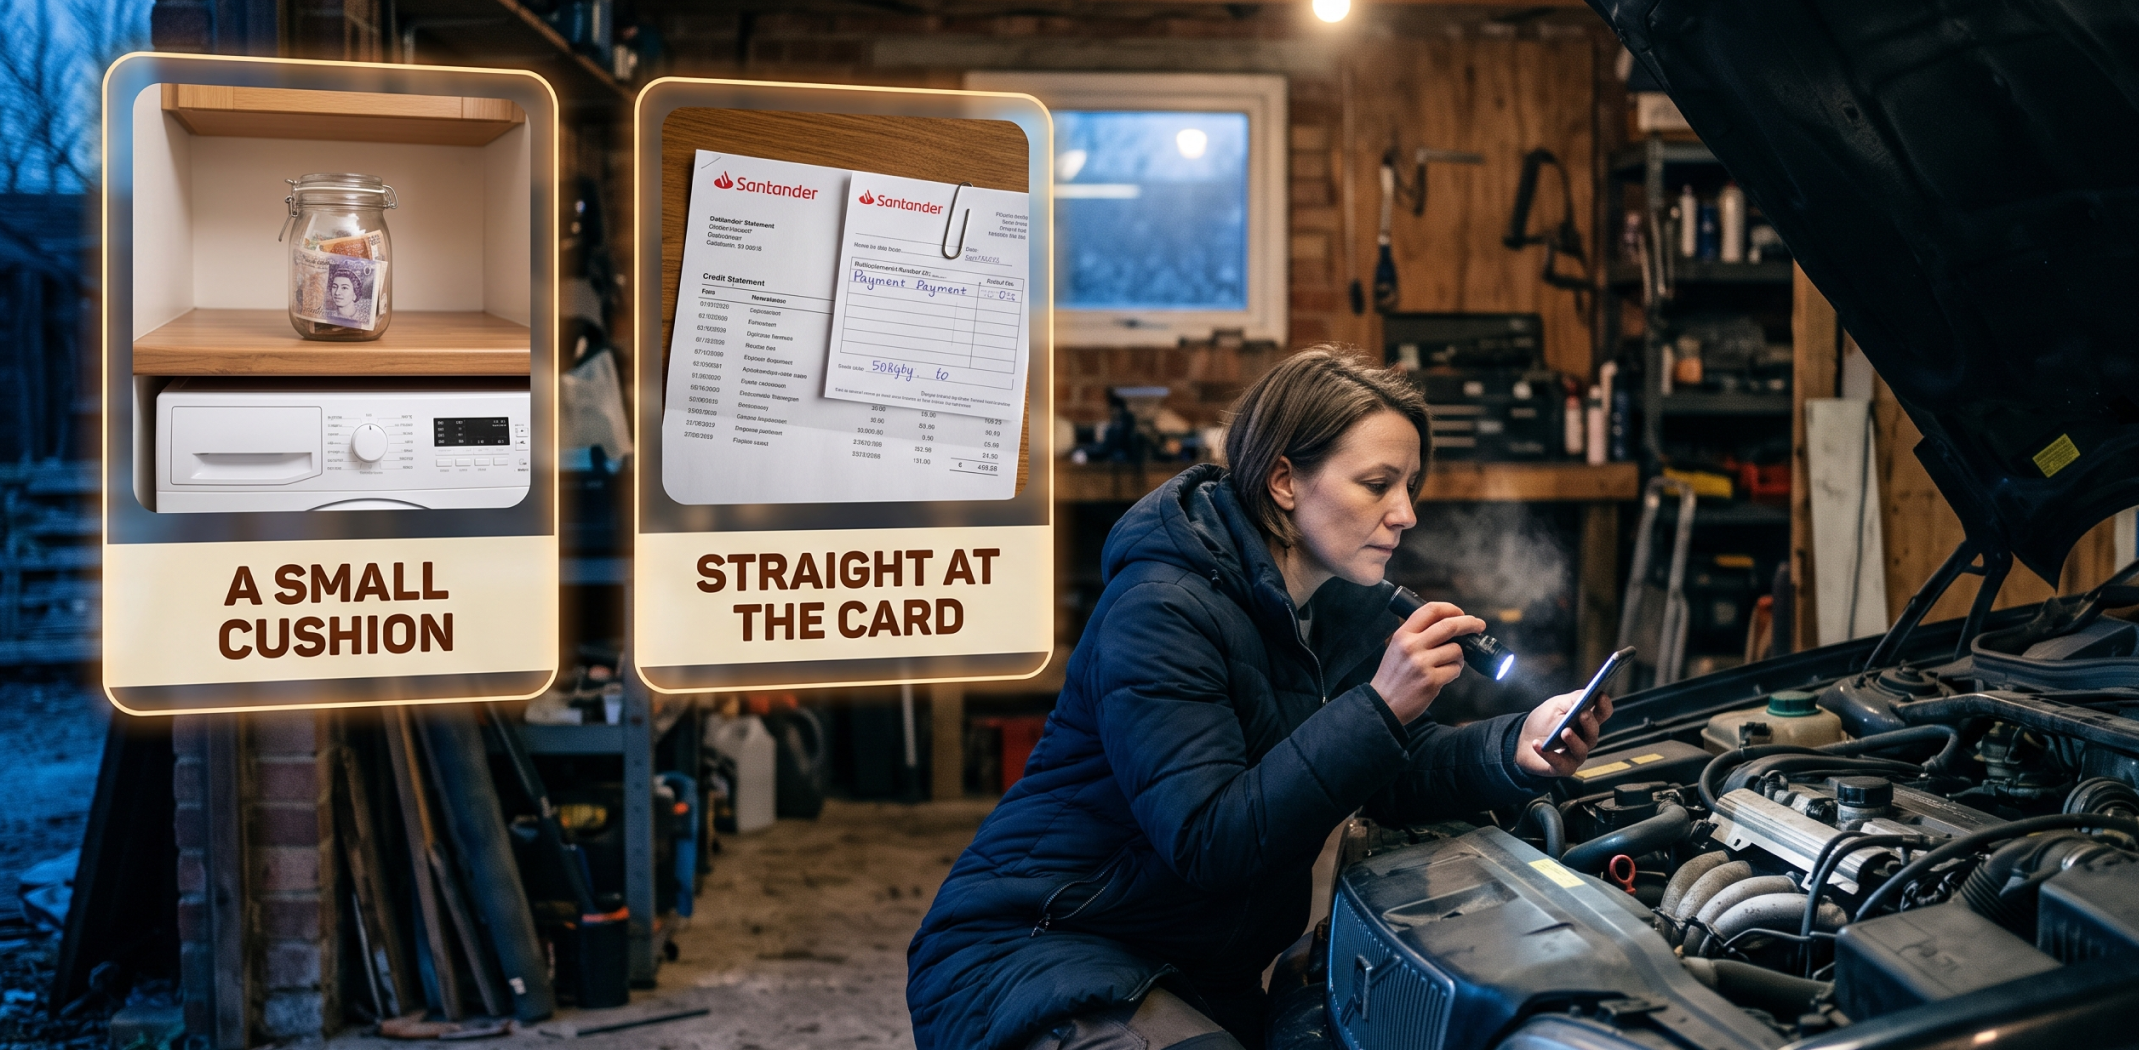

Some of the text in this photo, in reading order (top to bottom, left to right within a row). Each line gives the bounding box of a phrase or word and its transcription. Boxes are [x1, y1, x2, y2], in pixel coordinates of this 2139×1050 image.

[736, 176, 818, 200] Santander
[876, 194, 944, 215] Santander
[743, 219, 775, 229] Statement
[702, 272, 765, 287] Credit Statement
[853, 269, 906, 290] Payment
[916, 279, 967, 298] Payment
[935, 367, 949, 382] to
